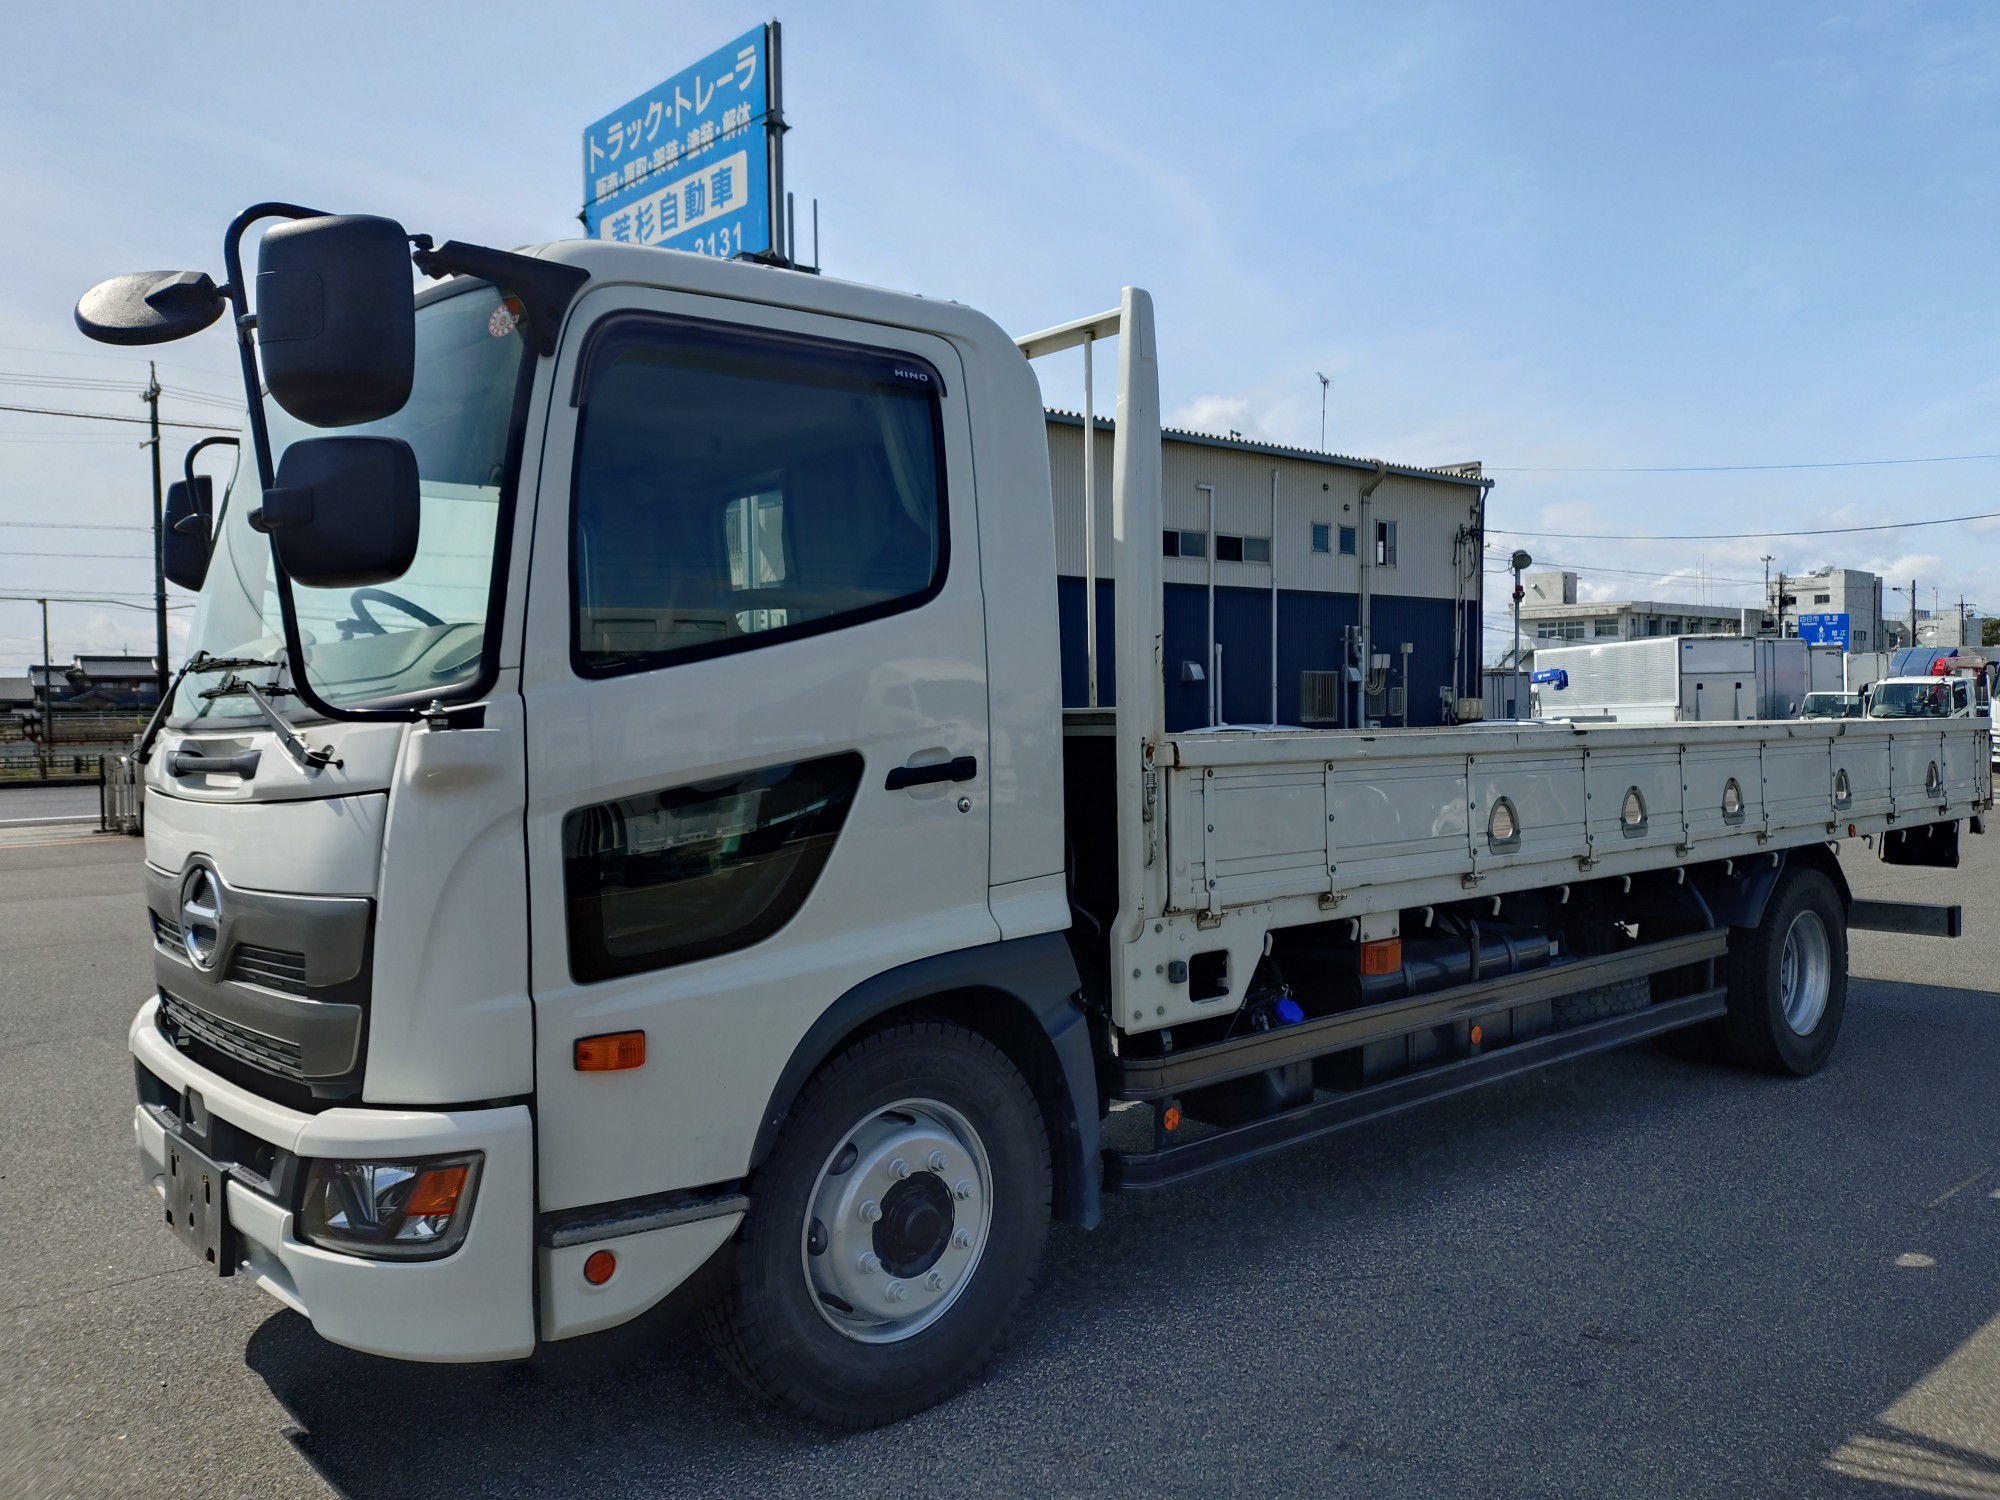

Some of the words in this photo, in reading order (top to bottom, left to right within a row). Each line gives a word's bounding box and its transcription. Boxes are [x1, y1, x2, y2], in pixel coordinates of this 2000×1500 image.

[590, 45, 757, 174] トラック・トレーラ
[894, 369, 928, 382] HINO
